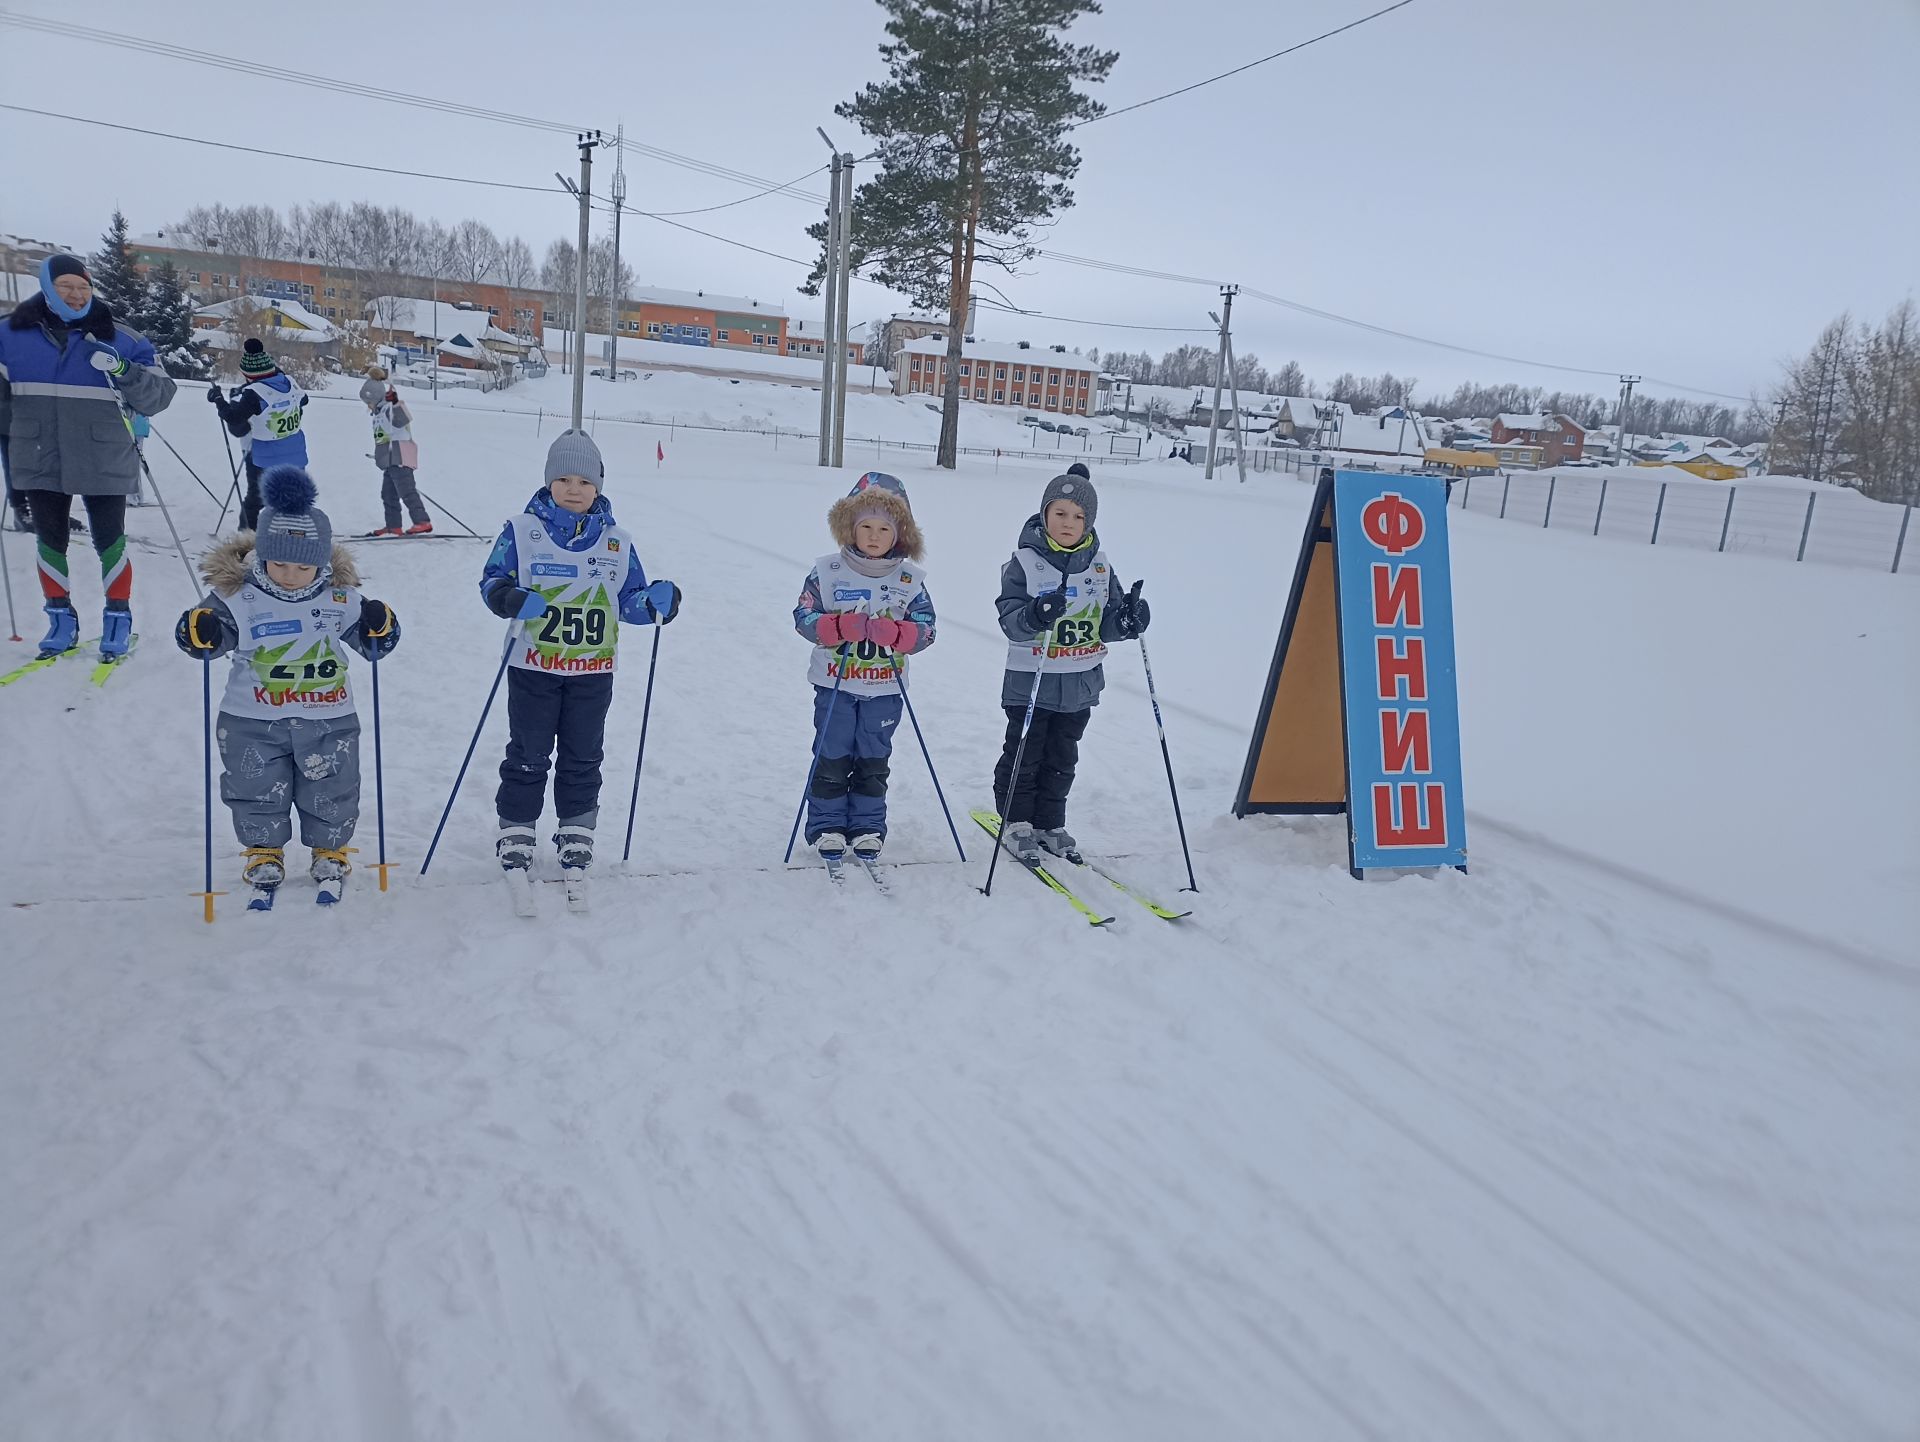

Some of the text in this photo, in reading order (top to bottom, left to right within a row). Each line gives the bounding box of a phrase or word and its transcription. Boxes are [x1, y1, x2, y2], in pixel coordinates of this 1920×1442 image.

[277, 413, 300, 433] 209
[538, 605, 606, 645] 259
[1057, 619, 1094, 646] 63
[525, 648, 613, 671] Kukmara
[1362, 493, 1447, 848] ФИНИШ
[253, 686, 347, 708] Kukmara
